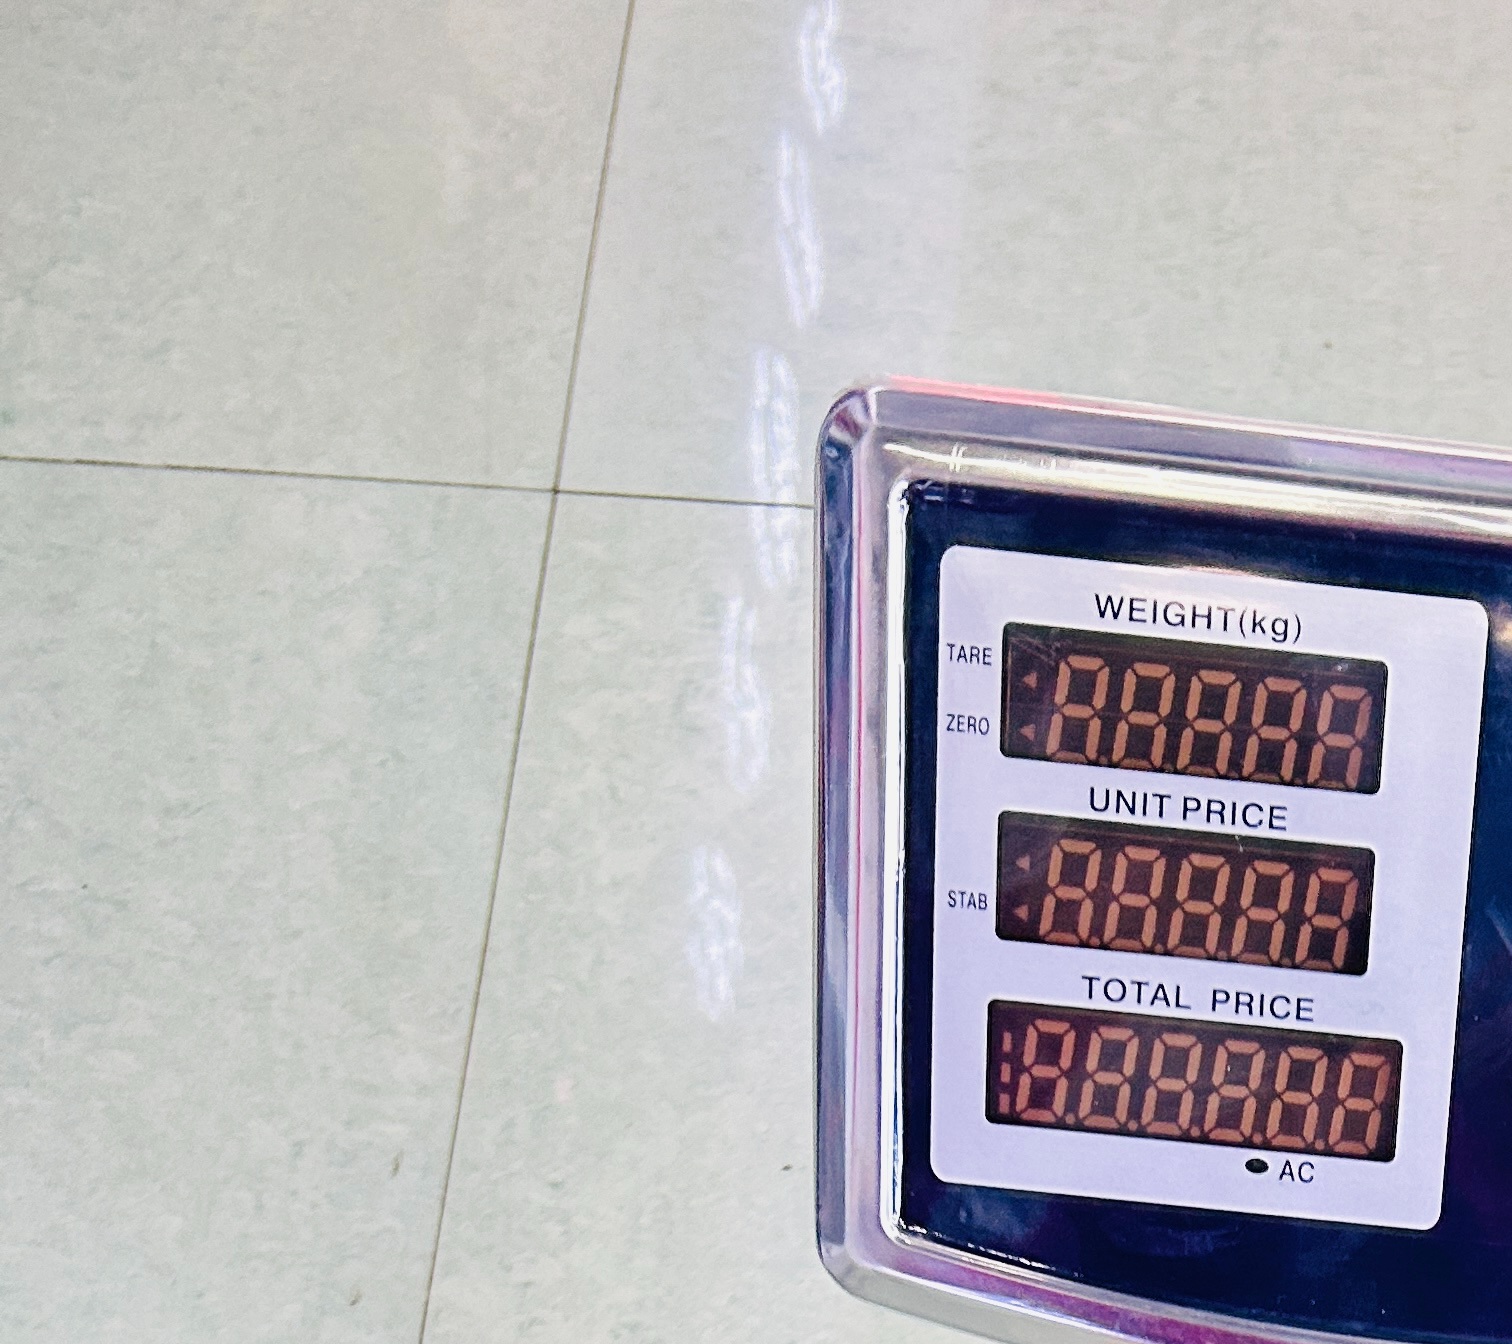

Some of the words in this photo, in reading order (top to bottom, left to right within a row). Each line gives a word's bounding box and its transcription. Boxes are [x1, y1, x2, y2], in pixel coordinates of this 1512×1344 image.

[1095, 593, 1303, 645] WEIGHT(kg)
[946, 643, 993, 667] TARE
[946, 713, 990, 737] ZERO
[1088, 786, 1172, 820] UNIT
[1182, 796, 1289, 832] PRICE
[947, 889, 989, 912] STAB
[1081, 975, 1193, 1011] TOTAL
[1212, 988, 1316, 1022] PRICE
[1279, 1160, 1316, 1184] AC
